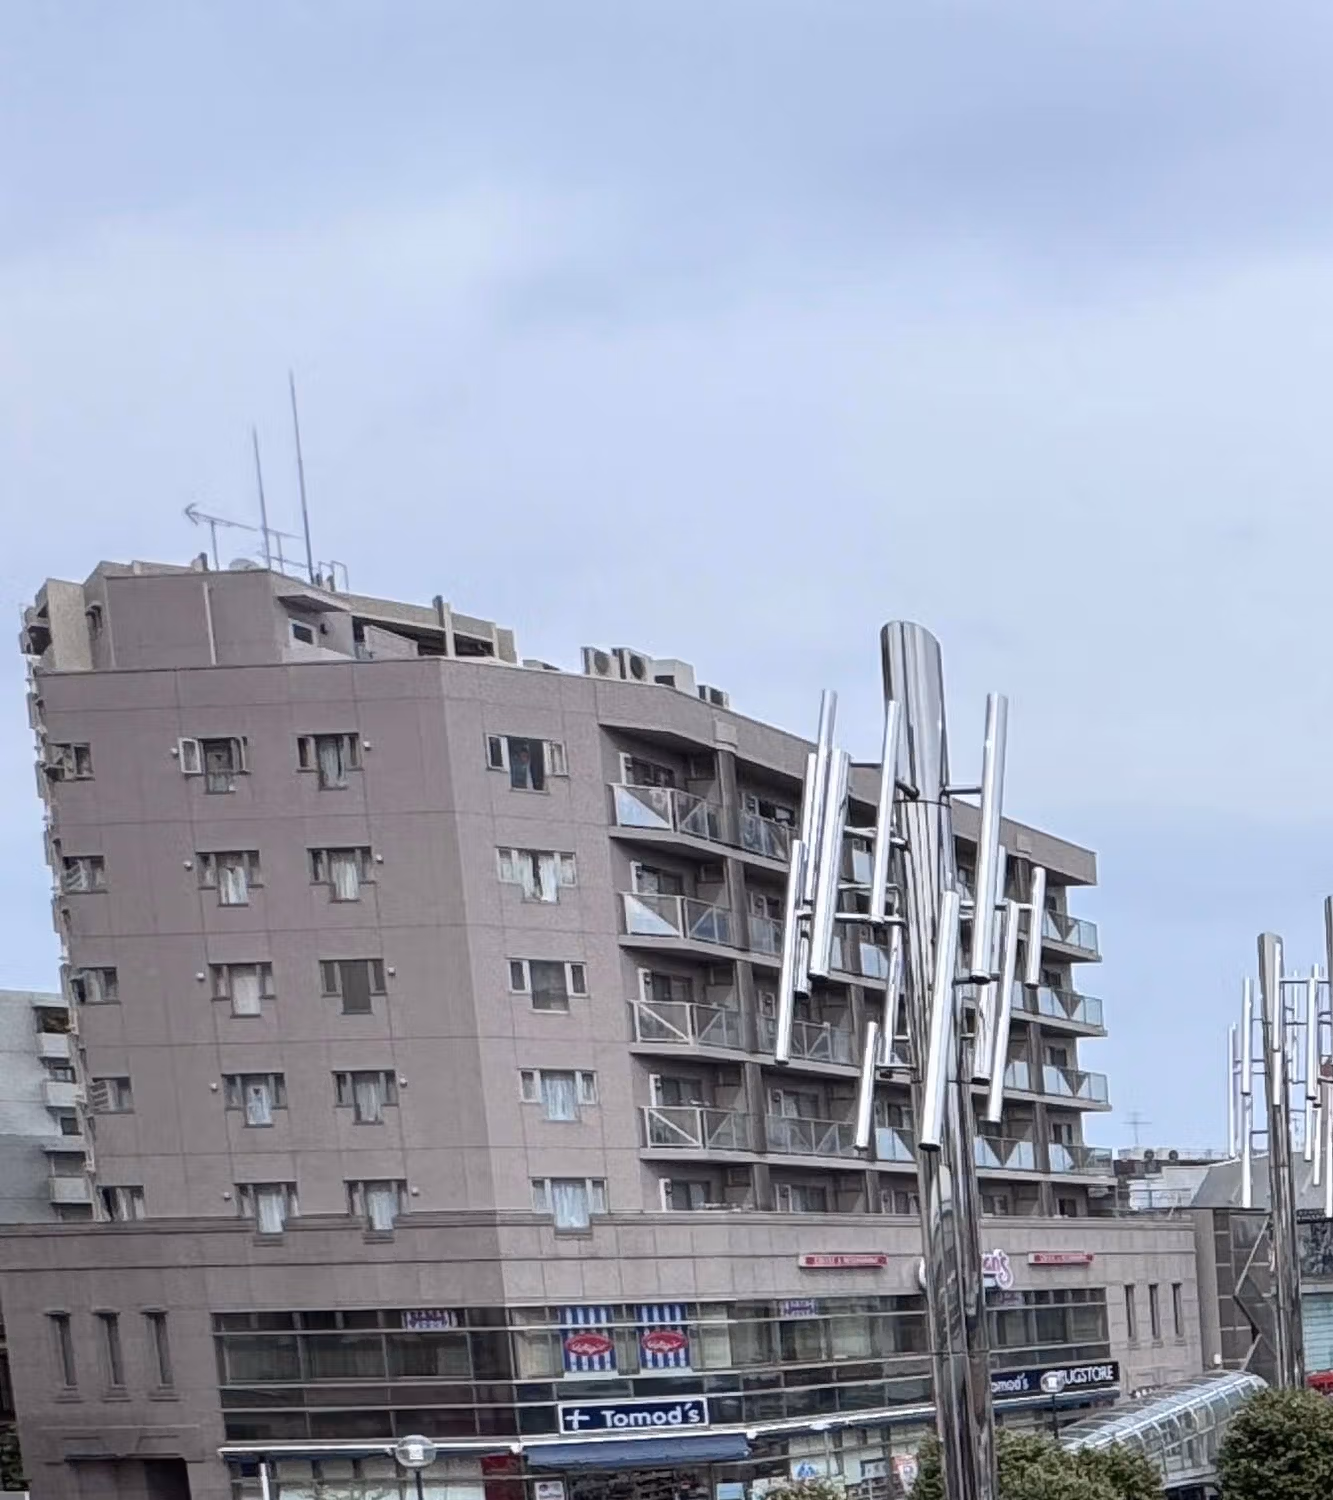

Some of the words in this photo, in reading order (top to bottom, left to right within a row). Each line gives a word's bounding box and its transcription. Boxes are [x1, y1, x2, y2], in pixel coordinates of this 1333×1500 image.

[990, 1373, 1030, 1393] omod's
[1062, 1365, 1114, 1385] UGSTORE
[600, 1402, 701, 1428] Tomod's
